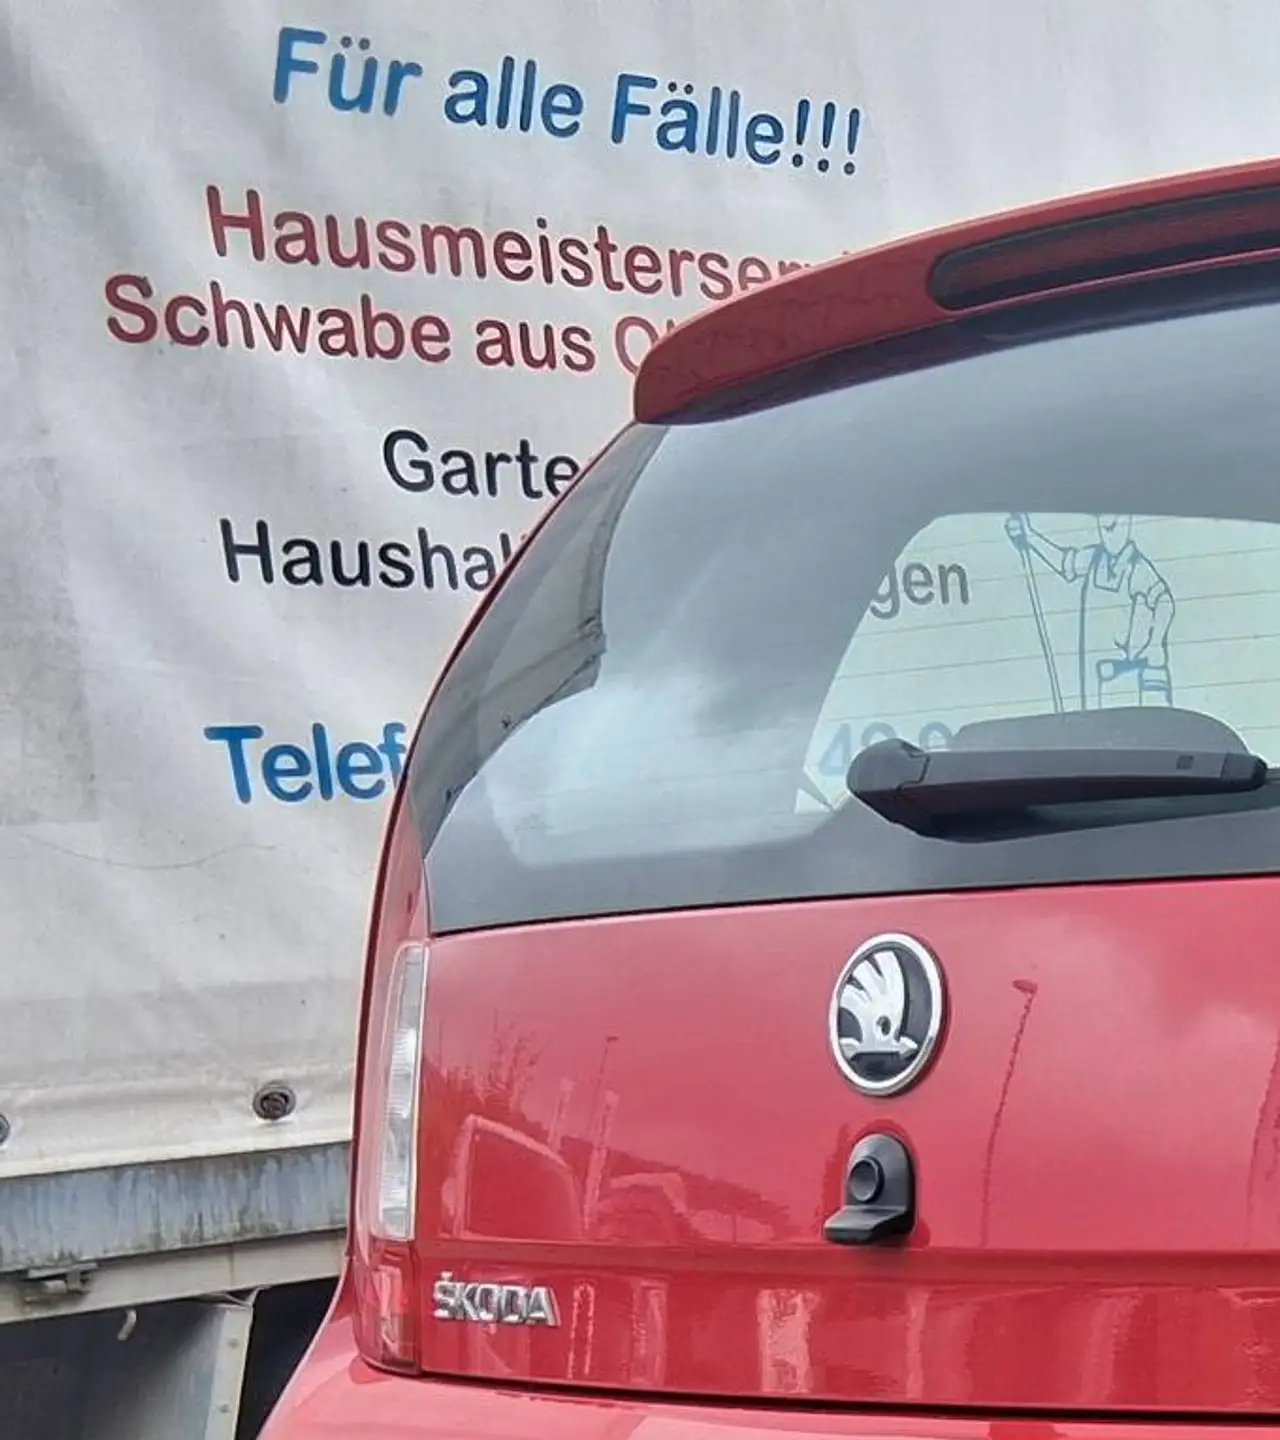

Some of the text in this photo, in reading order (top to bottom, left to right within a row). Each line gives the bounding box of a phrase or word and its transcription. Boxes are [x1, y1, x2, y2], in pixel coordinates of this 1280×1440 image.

[272, 26, 861, 176] Für alle Fälle!!!
[104, 273, 452, 364] Schwabe
[475, 316, 597, 372] aus
[219, 517, 527, 592] Haushal
